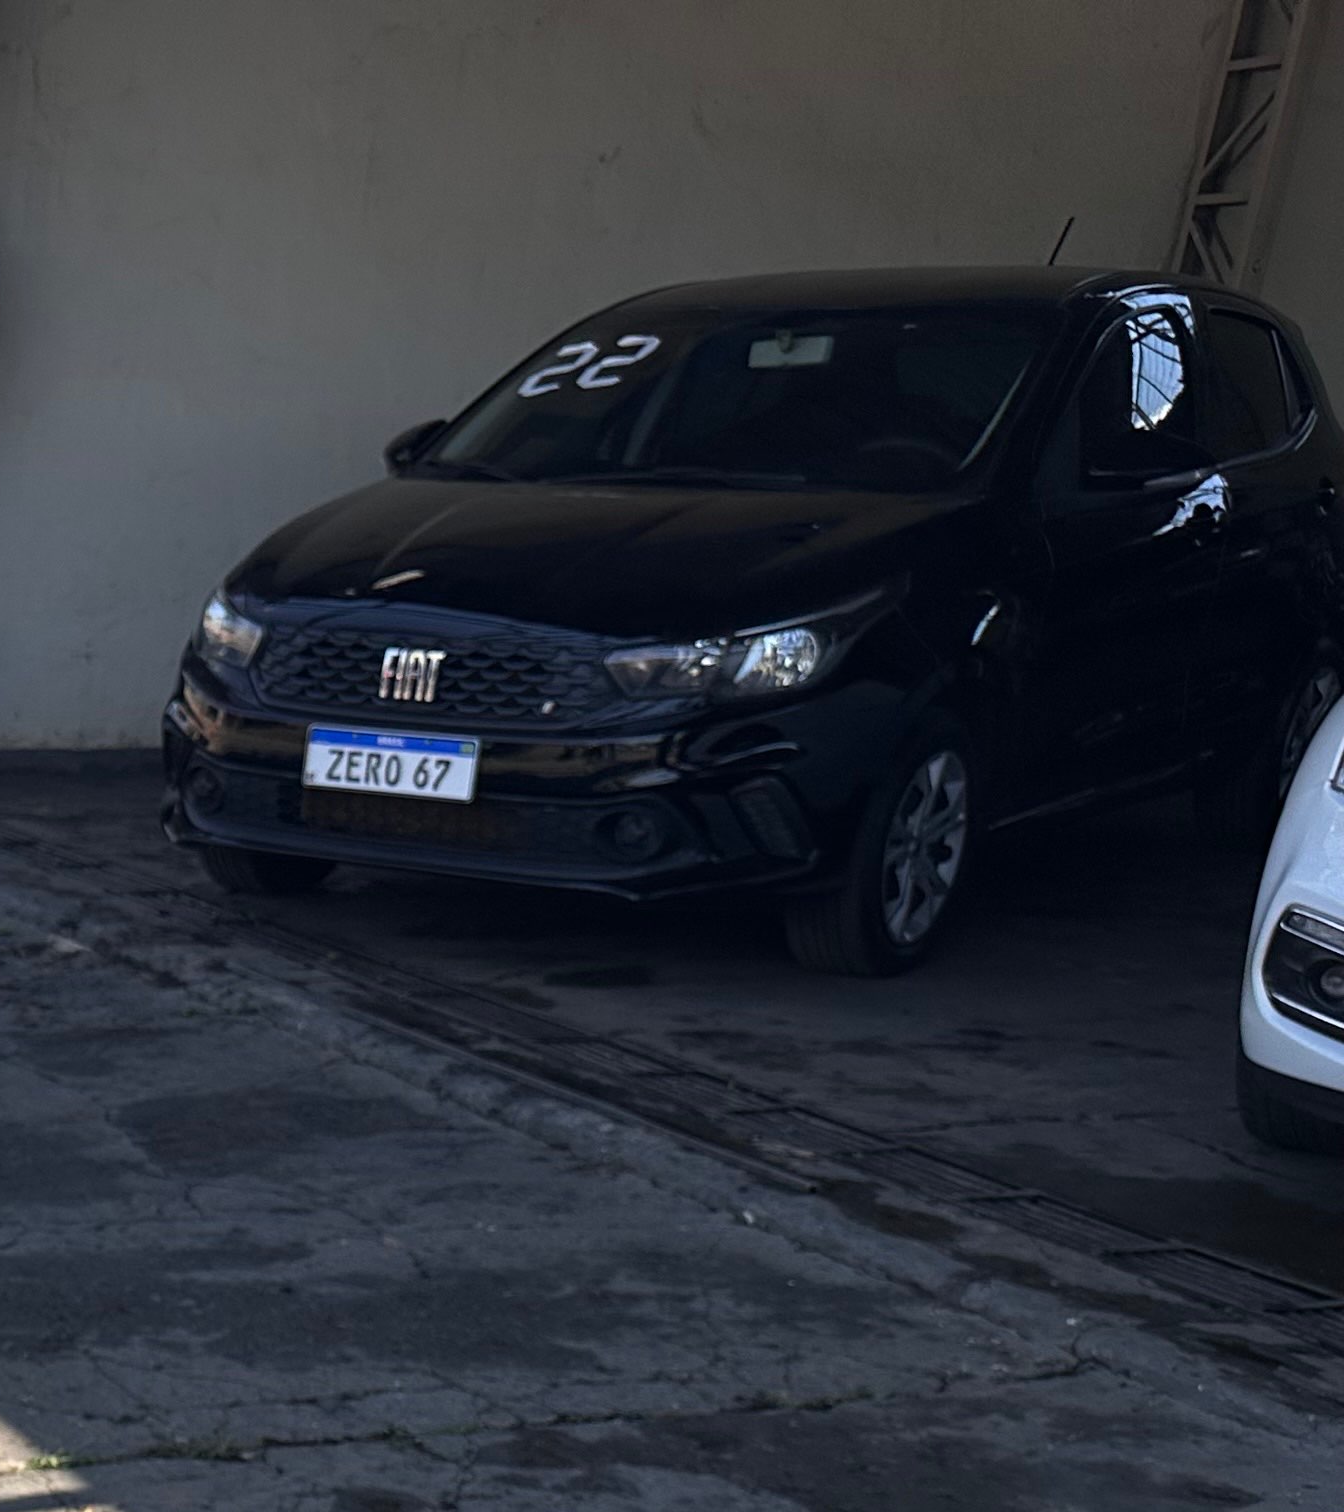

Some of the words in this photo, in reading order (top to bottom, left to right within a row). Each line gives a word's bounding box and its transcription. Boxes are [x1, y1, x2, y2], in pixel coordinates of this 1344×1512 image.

[517, 334, 661, 397] 22
[378, 646, 447, 702] FIAT
[326, 749, 402, 787] ZERO
[413, 757, 452, 792] 67
